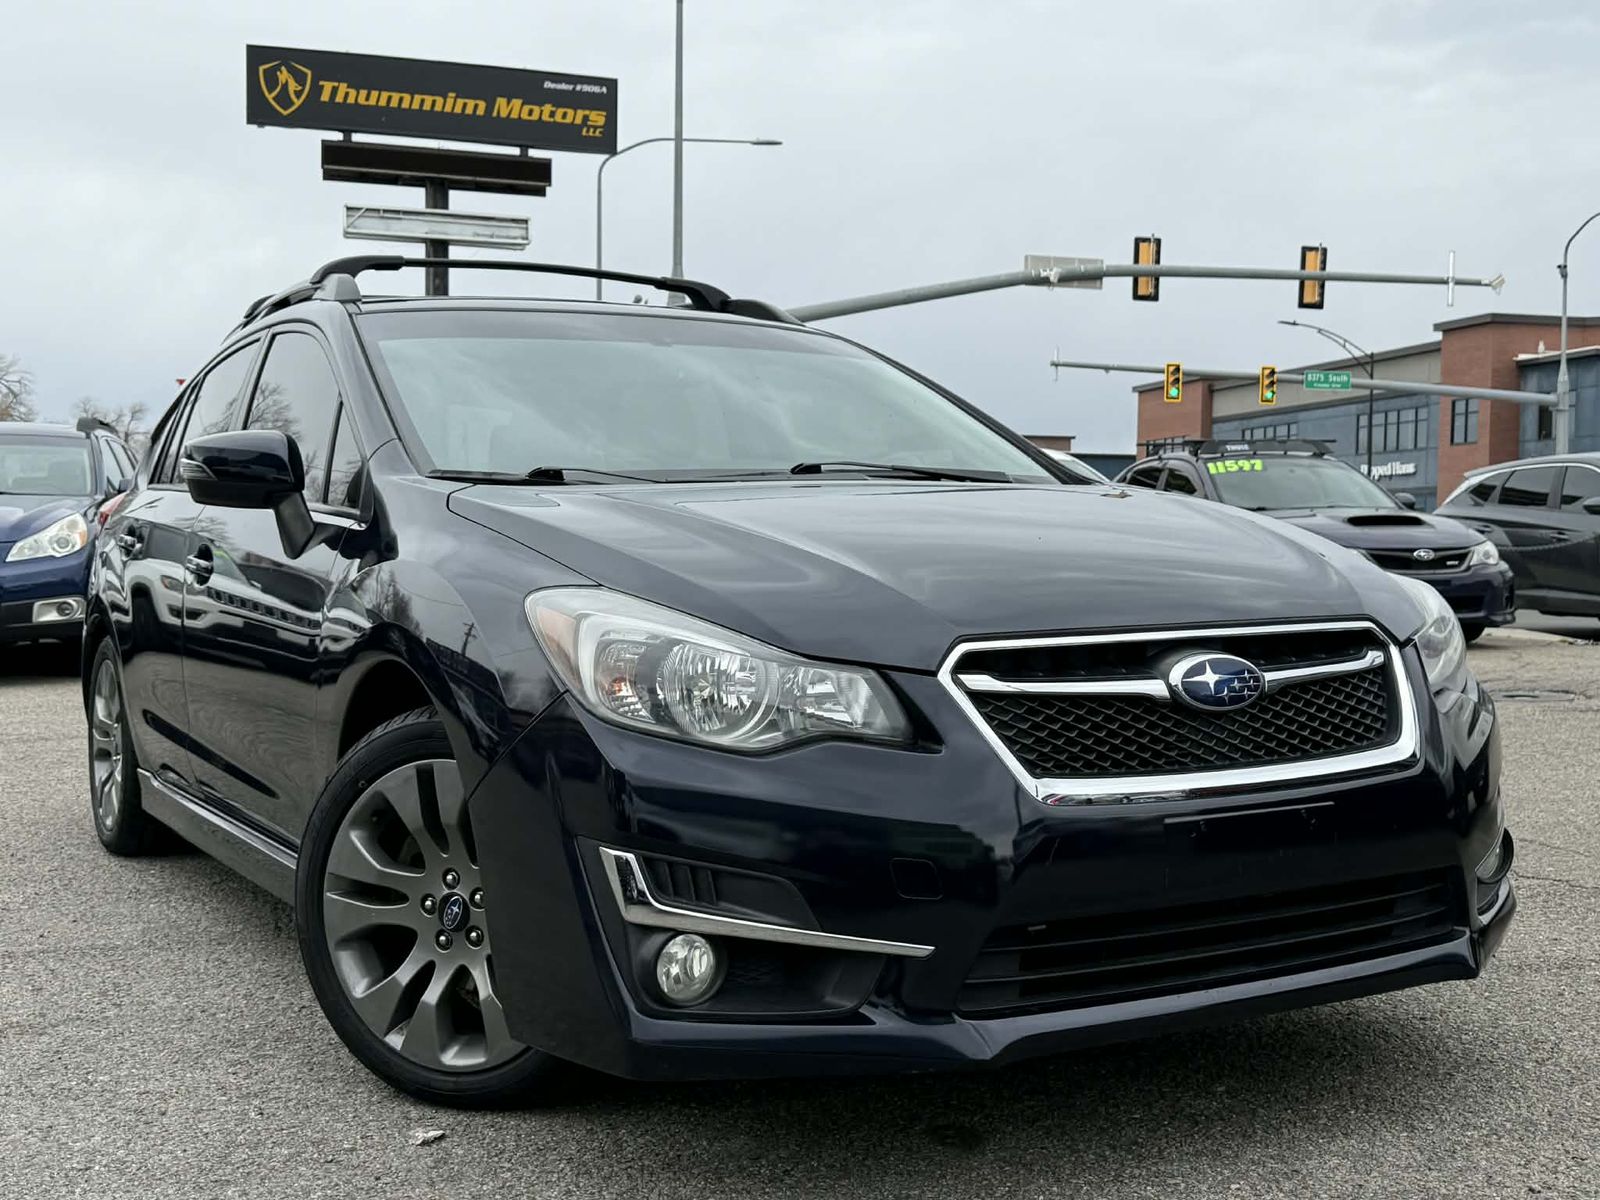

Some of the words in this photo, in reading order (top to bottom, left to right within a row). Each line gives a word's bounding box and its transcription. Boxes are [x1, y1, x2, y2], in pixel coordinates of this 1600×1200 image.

[544, 80, 574, 91] Dealer
[319, 81, 485, 116] Thummim
[492, 97, 607, 126] Motors
[581, 127, 604, 137] LLC
[1328, 374, 1348, 383] South
[1207, 459, 1263, 475] 11597
